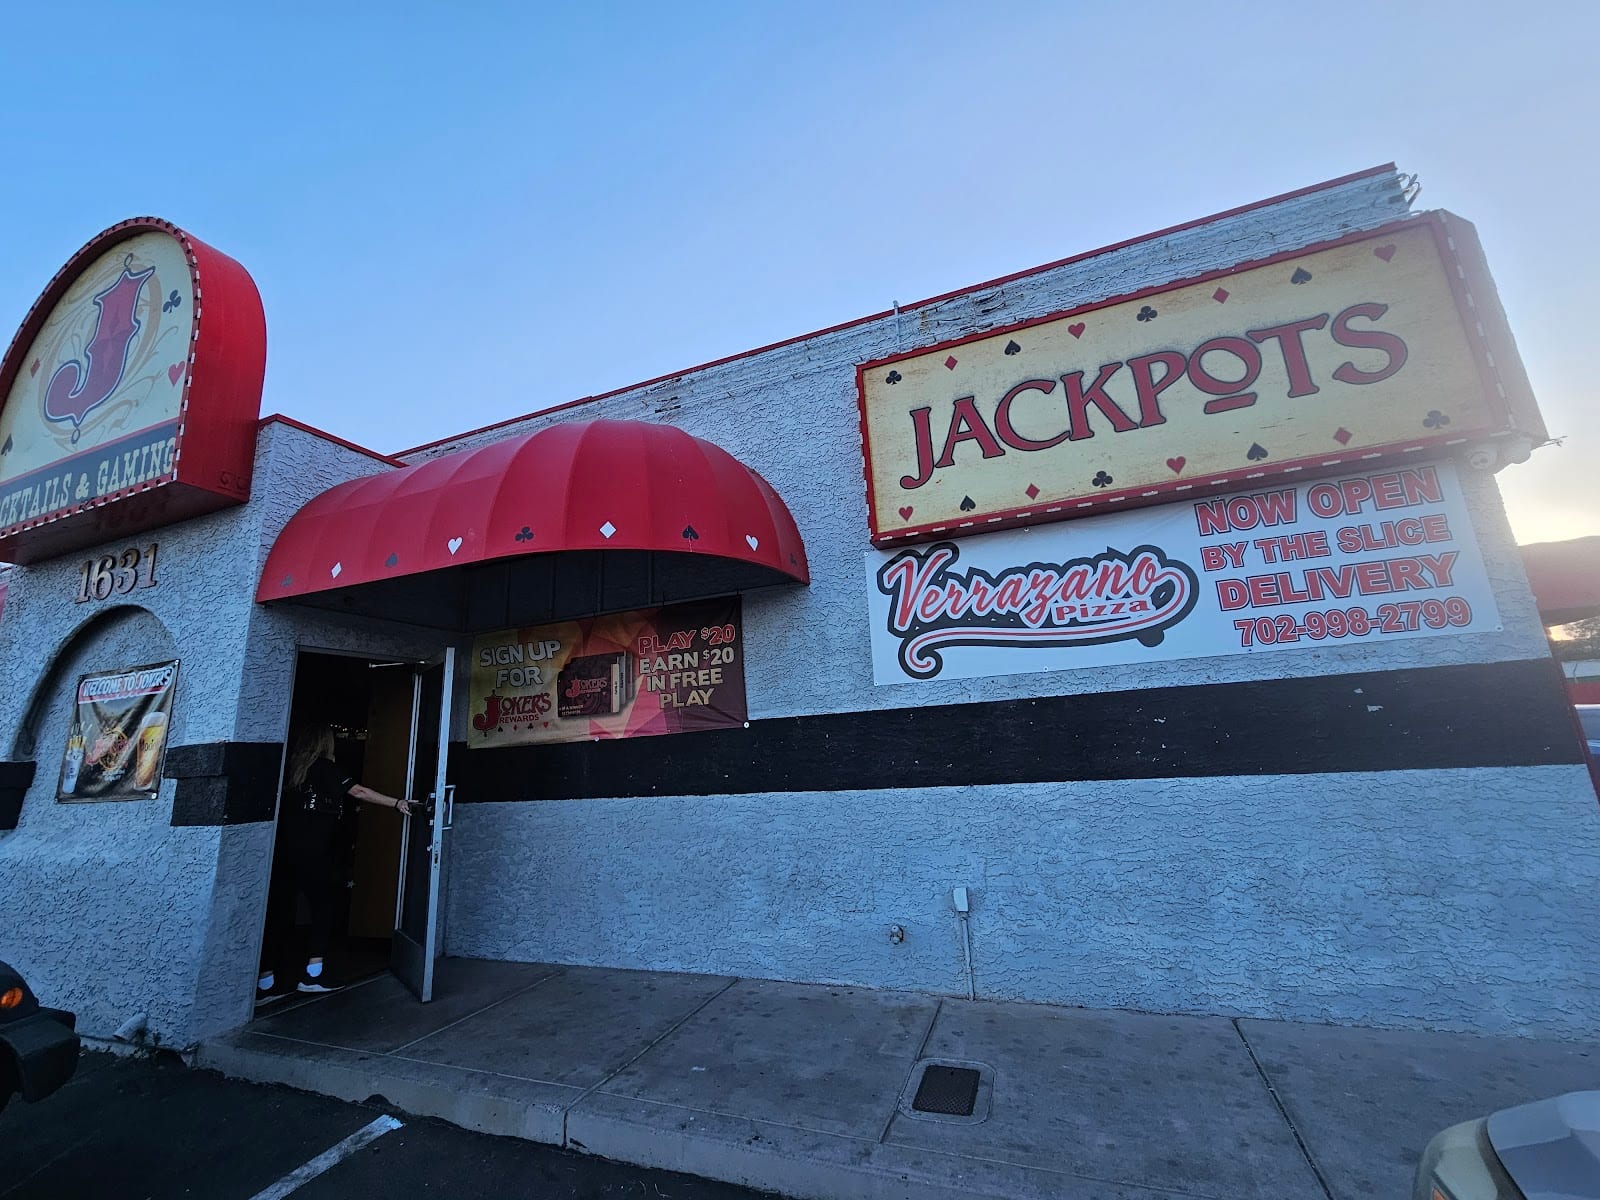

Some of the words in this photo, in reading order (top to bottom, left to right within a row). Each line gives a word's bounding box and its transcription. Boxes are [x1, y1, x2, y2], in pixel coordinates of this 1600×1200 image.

[44, 252, 156, 446] J
[900, 302, 1409, 490] JACKPOTS
[0, 471, 73, 528] CKTAILS
[75, 472, 90, 500] &
[96, 436, 177, 496] GAMING
[1194, 488, 1297, 537] NOW
[1306, 465, 1444, 519] OPEN
[1200, 541, 1249, 572] BY
[1254, 530, 1330, 564] THE
[1336, 514, 1453, 554] SLICE
[75, 543, 159, 605] 1631
[885, 548, 1157, 629] Verrazano
[1215, 551, 1459, 611] DELIVERY
[1053, 598, 1153, 623] Pizza
[1234, 596, 1472, 647] 702-998-2799
[479, 643, 524, 667] SIGN
[528, 639, 561, 660] UP
[638, 629, 697, 654] PLAY
[700, 623, 736, 646] $20
[496, 666, 544, 689] FOR
[639, 650, 699, 675] EARN
[702, 646, 735, 667] $20
[646, 673, 666, 692] IN
[670, 668, 723, 689] FREE
[83, 677, 122, 697] WELCOME
[124, 675, 136, 692] TO
[659, 688, 714, 709] PLAY
[499, 713, 540, 724] REWARDS
